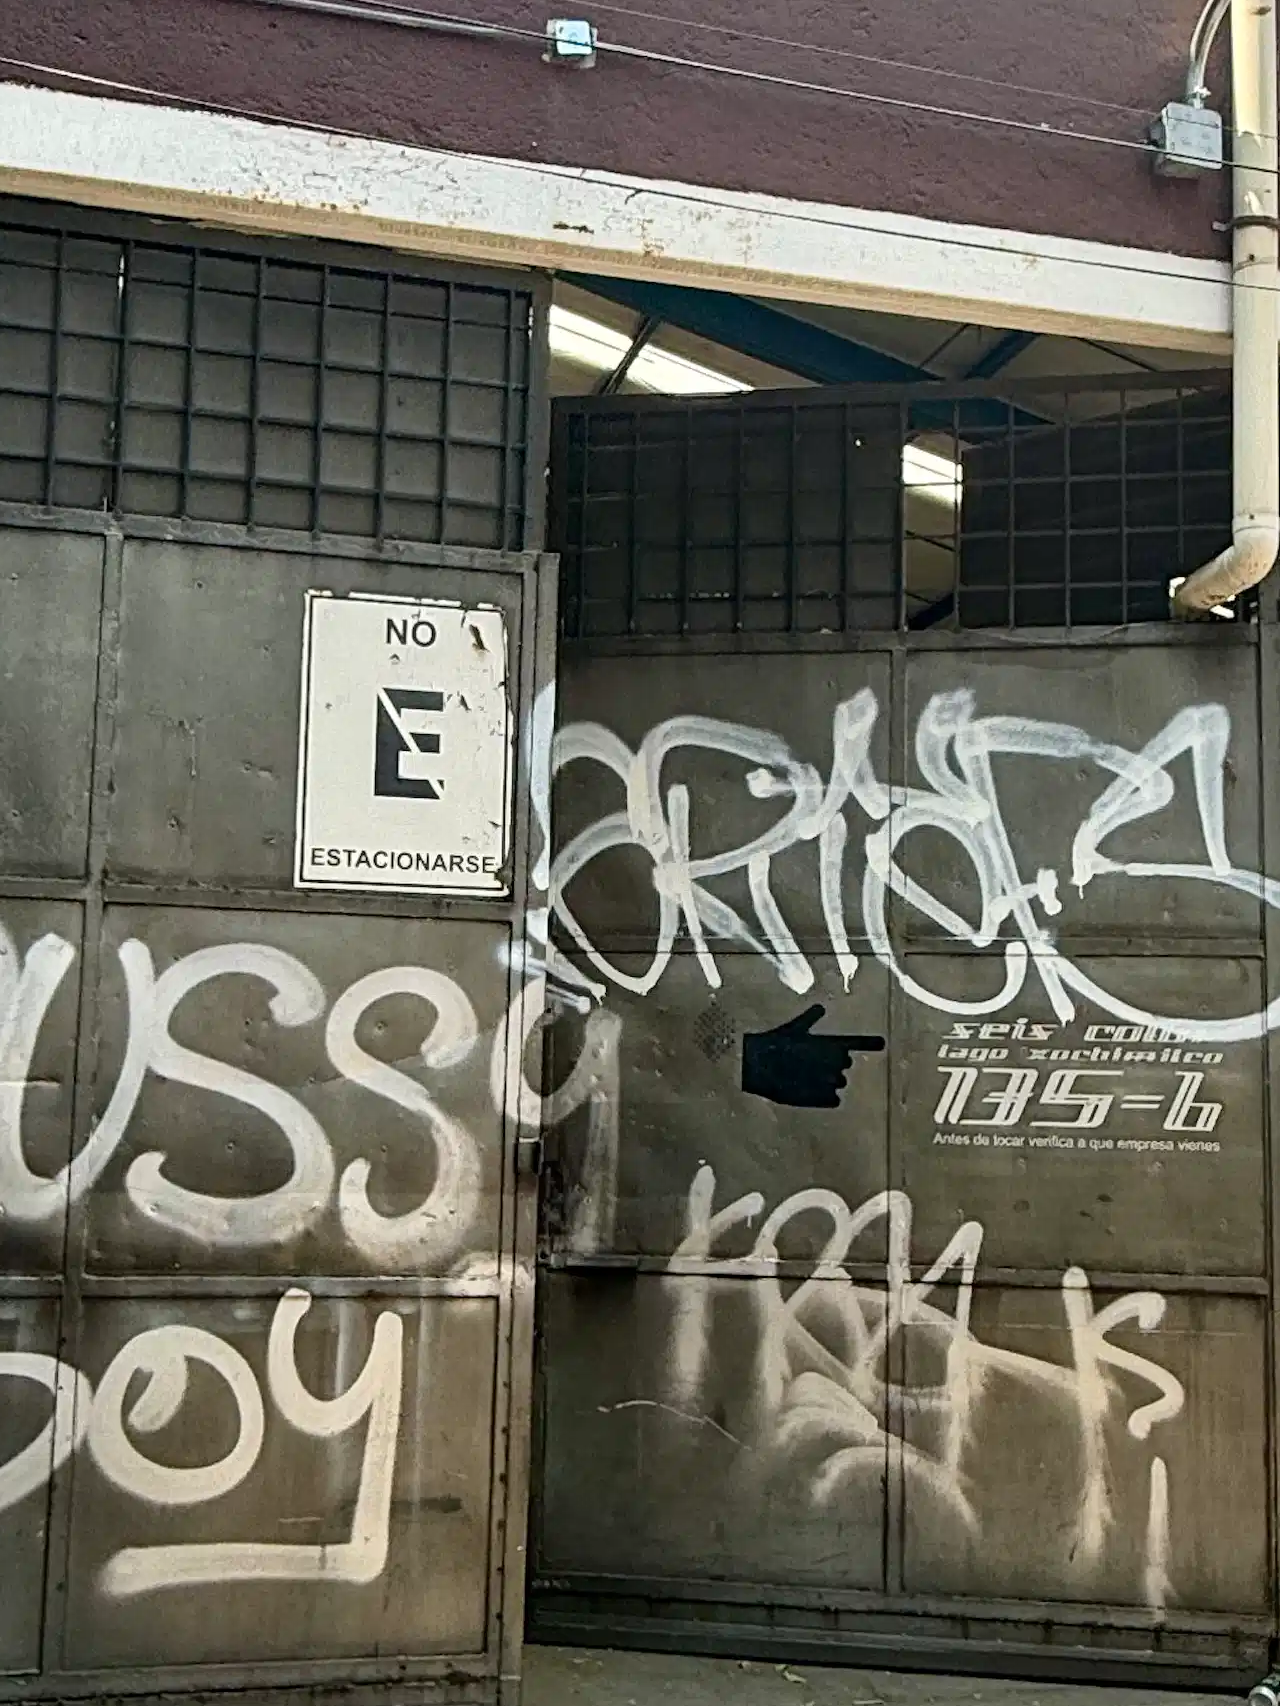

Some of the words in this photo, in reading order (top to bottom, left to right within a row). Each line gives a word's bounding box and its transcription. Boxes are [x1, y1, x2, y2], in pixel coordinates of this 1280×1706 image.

[386, 618, 437, 648] NO
[374, 688, 445, 800] E
[310, 848, 496, 874] ESTACIONARSE
[942, 1018, 1059, 1041] seis
[937, 1044, 1009, 1061] lago
[1026, 1046, 1224, 1065] xochimilco
[933, 1132, 970, 1145] Antes
[973, 1133, 990, 1146] de
[993, 1134, 1025, 1147] tocar
[1029, 1135, 1074, 1149] verifica
[1077, 1139, 1087, 1149] a
[1089, 1139, 1114, 1151] que
[1116, 1140, 1175, 1152] empresa
[1177, 1139, 1221, 1152] vienes
